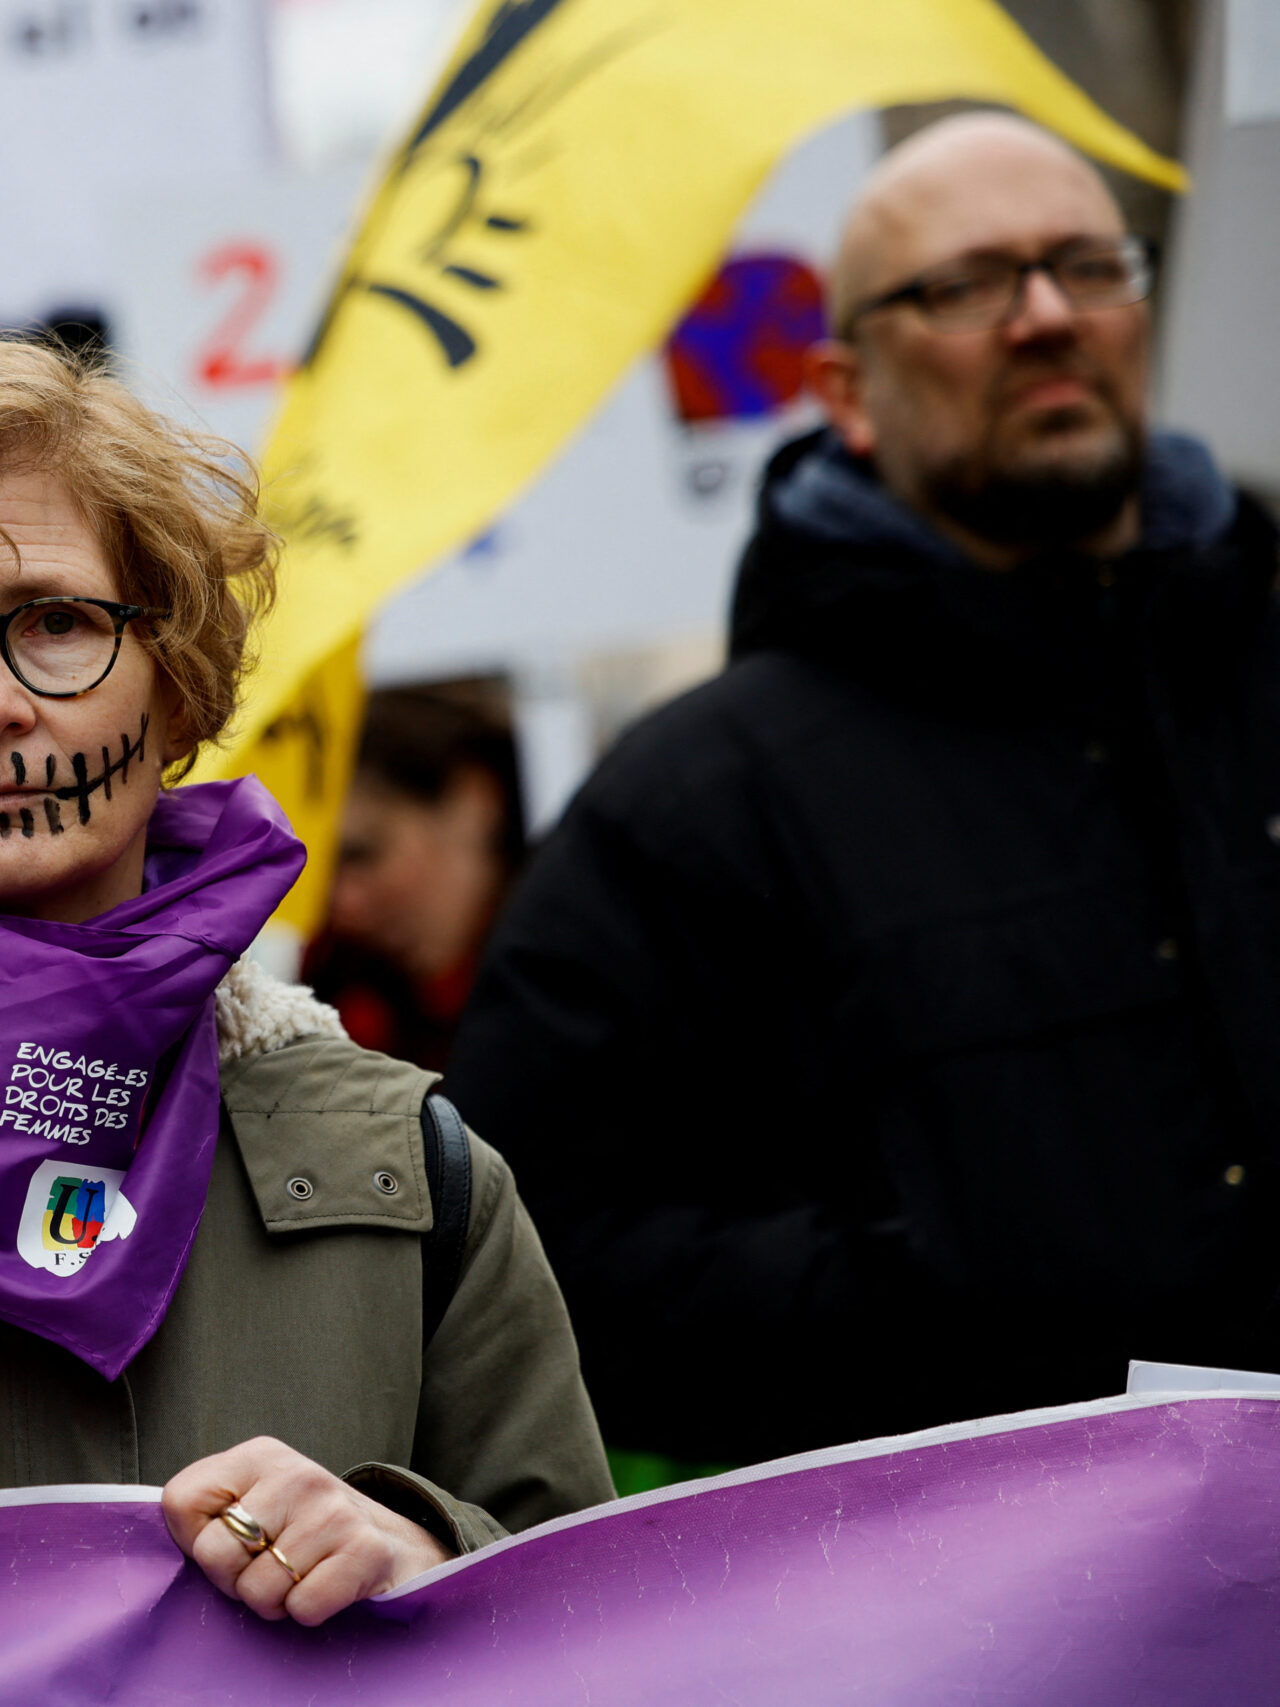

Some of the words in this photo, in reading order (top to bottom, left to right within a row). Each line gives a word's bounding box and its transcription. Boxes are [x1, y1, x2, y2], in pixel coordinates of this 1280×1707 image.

[10, 1064, 83, 1098] POUR
[91, 1083, 131, 1107] LES
[16, 1042, 148, 1087] ENGAGÉ-ES
[5, 1086, 89, 1121] DROITS
[94, 1108, 128, 1129] DES
